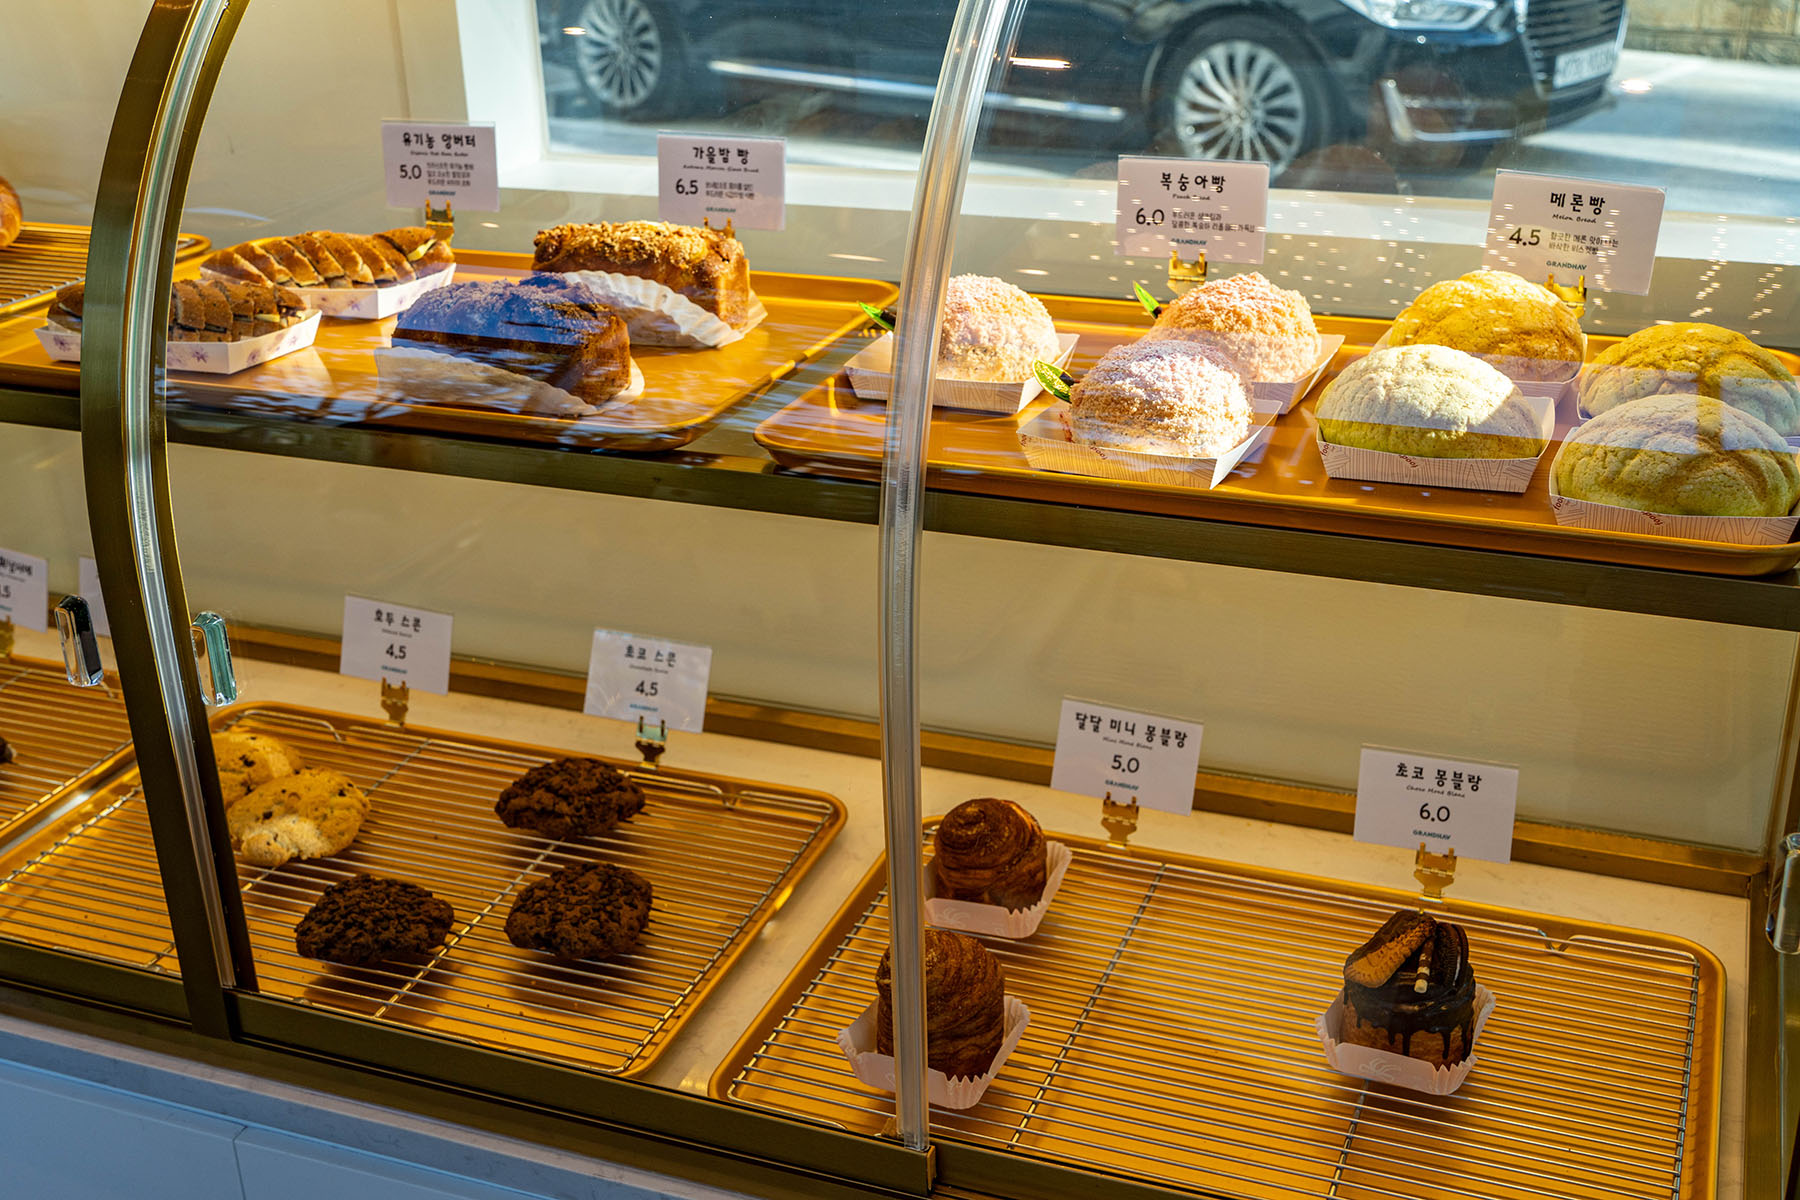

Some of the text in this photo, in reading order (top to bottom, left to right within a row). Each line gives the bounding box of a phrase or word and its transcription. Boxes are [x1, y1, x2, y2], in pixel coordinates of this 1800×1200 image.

[402, 132, 476, 150] 유기농 앙버터
[692, 146, 749, 165] 가을밤 빵
[399, 164, 422, 180] 5.0
[675, 178, 699, 196] 6.5
[1160, 172, 1226, 194] 복숭아빵
[1550, 192, 1606, 216] 메론빵
[1135, 207, 1165, 226] 6.0
[1552, 213, 1597, 224] Melon Bread
[1508, 227, 1541, 247] 4.5
[1546, 260, 1587, 270] GRANDNAV
[374, 608, 395, 627] 호두
[401, 615, 421, 633] 스콘
[386, 643, 407, 660] 4.5
[654, 650, 676, 668] 스콘
[635, 680, 659, 697] 4.5
[1075, 712, 1188, 749] 달달 미니 몽블랑
[1111, 754, 1140, 774] 5.0
[1395, 762, 1482, 793] 초코 몽블랑
[1419, 802, 1451, 823] 6.0
